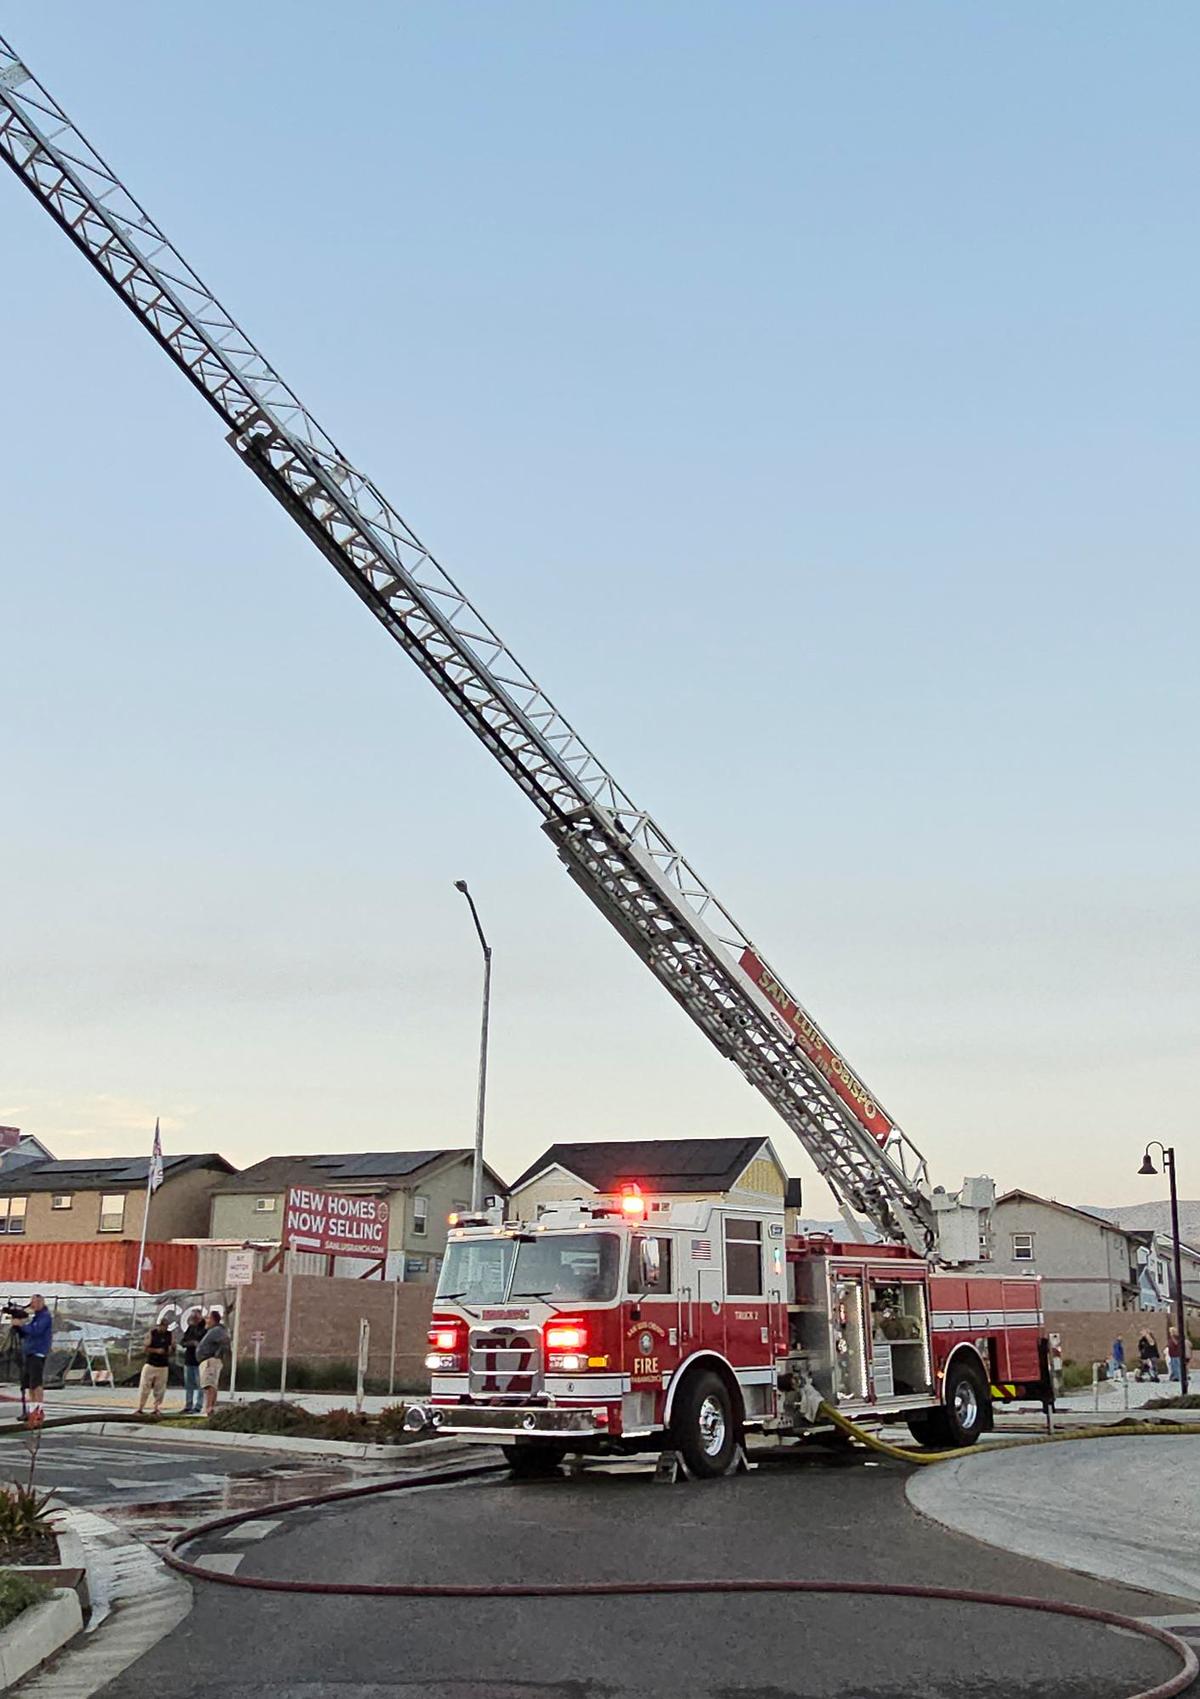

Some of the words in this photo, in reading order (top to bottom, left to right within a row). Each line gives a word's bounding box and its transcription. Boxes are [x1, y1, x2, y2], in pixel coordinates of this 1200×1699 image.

[758, 971, 790, 1010] SAN
[792, 1011, 825, 1051] LUIS
[830, 1057, 877, 1120] OBISPO
[289, 1188, 325, 1212] NEW
[328, 1195, 376, 1220] HOMES
[287, 1211, 326, 1234] NOW
[328, 1218, 383, 1241] SELLING
[476, 1337, 533, 1391] T2
[634, 1357, 659, 1375] FIRE
